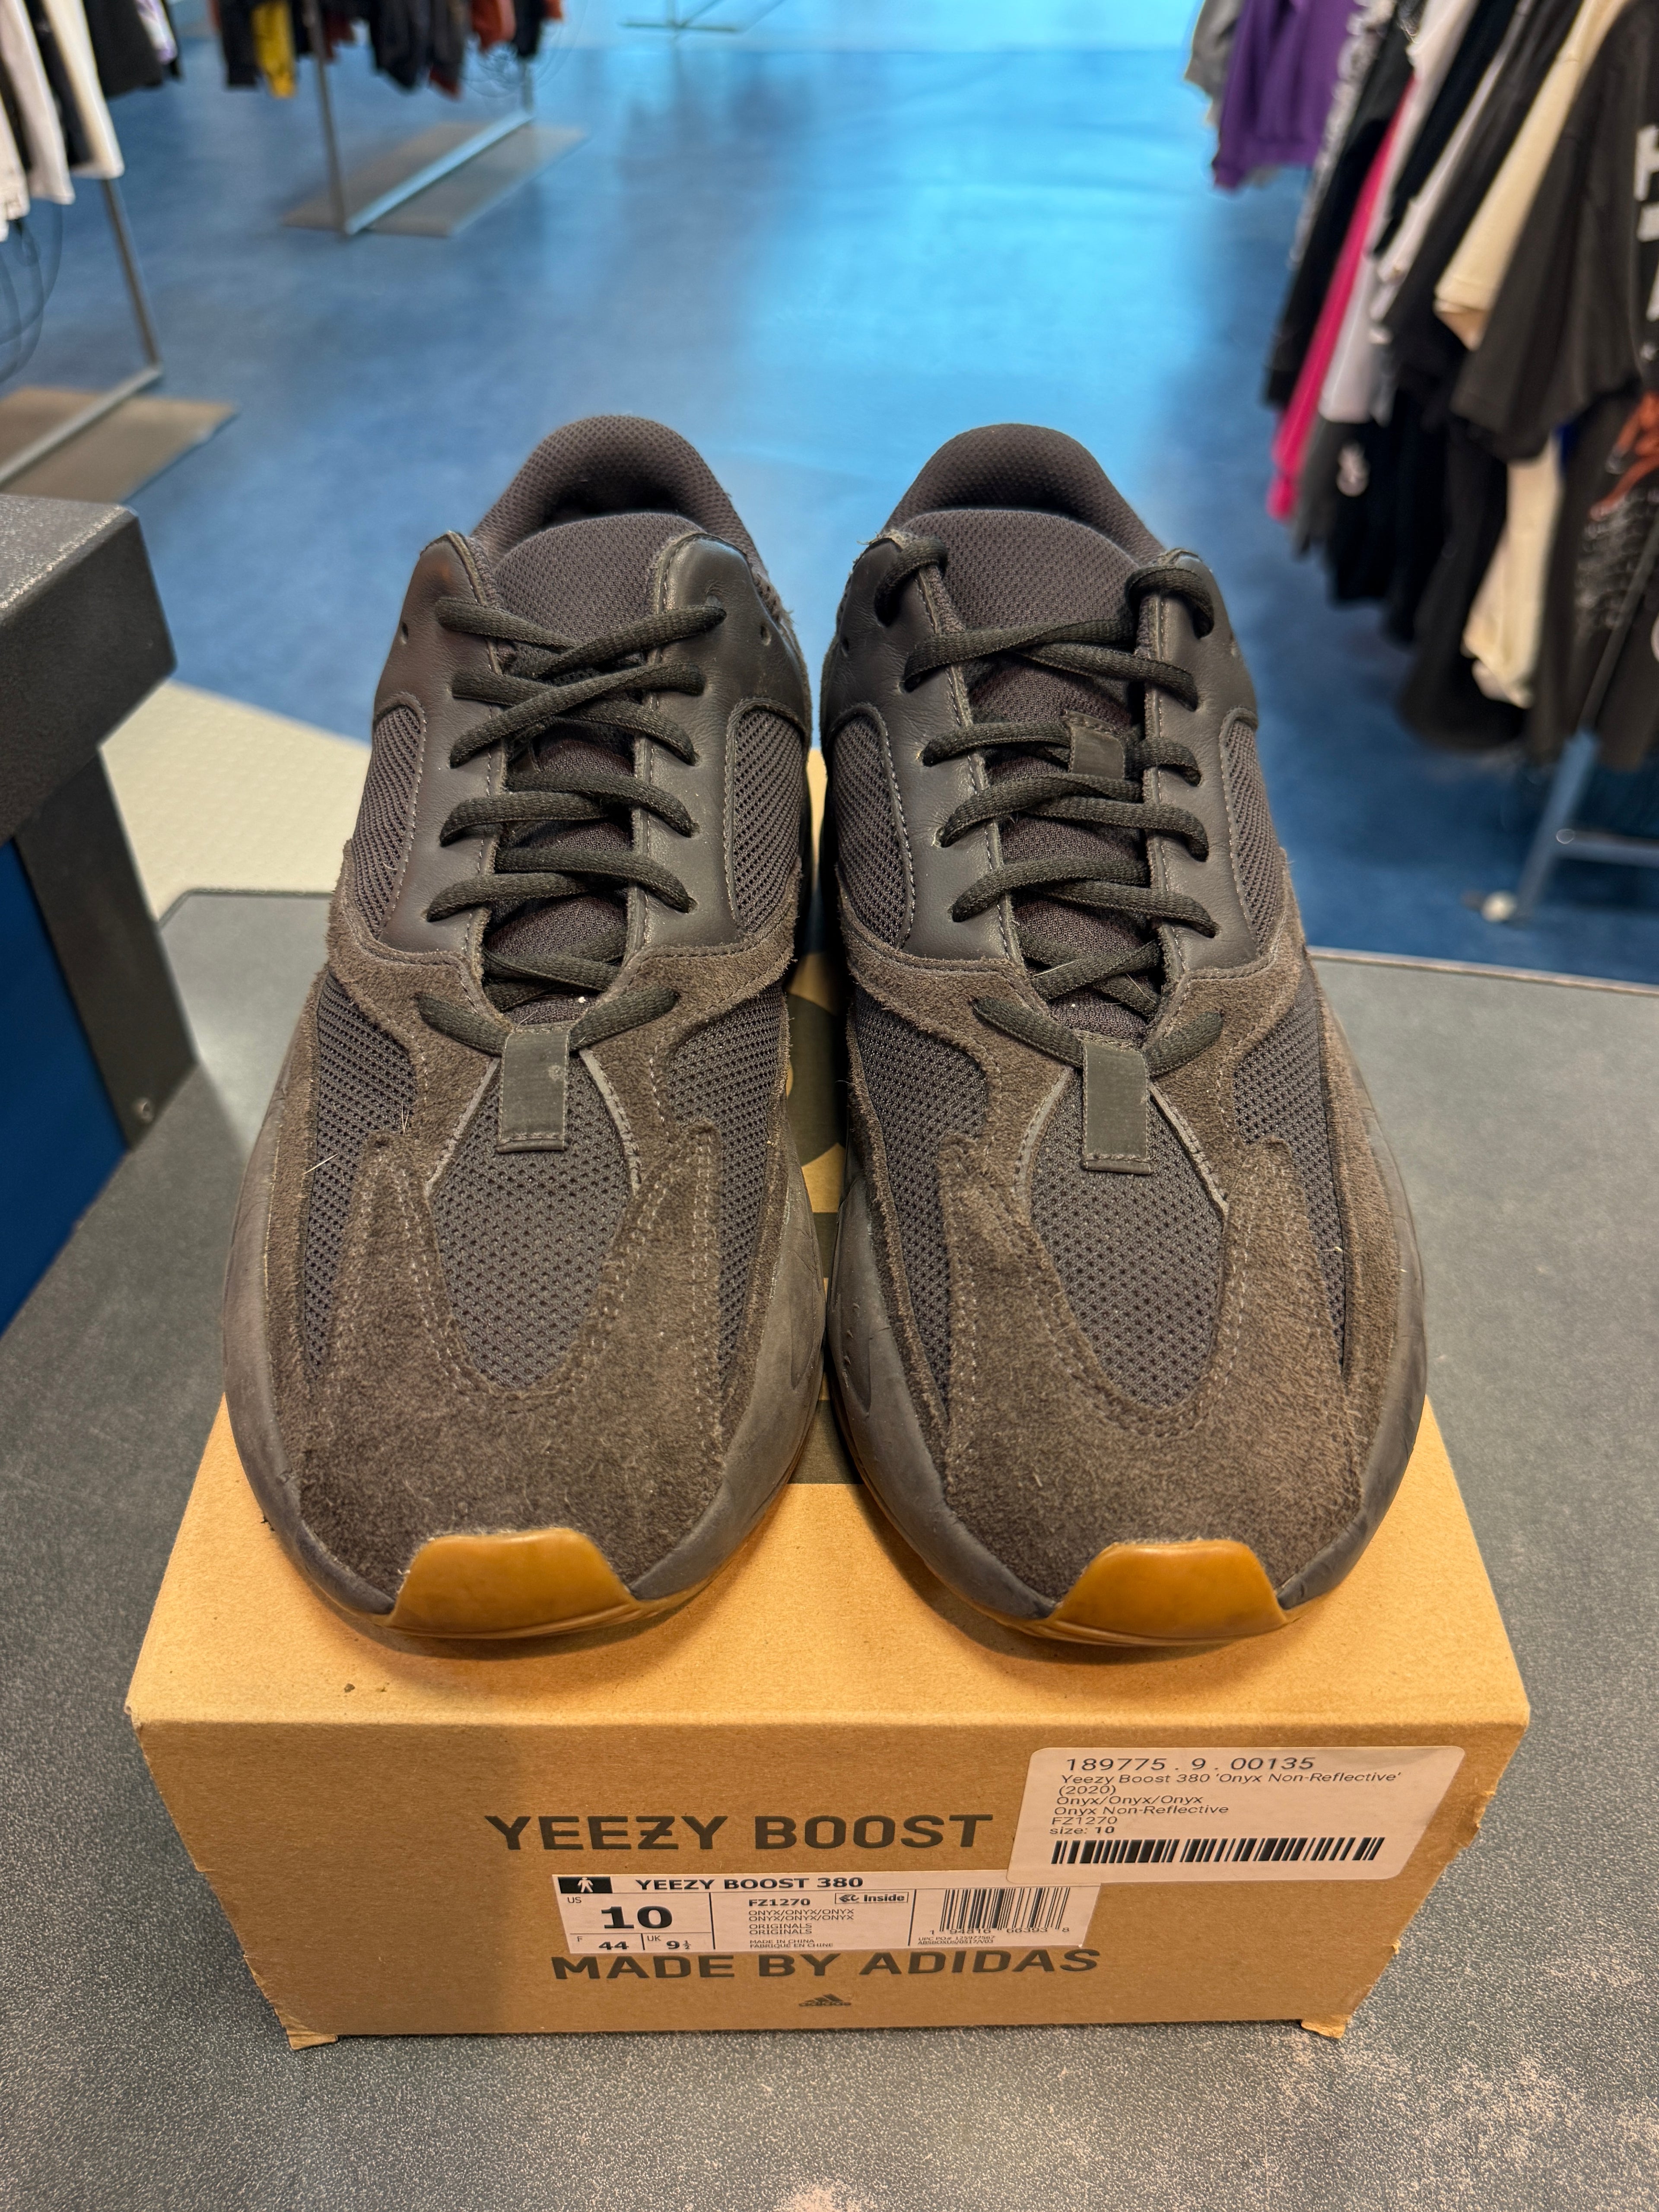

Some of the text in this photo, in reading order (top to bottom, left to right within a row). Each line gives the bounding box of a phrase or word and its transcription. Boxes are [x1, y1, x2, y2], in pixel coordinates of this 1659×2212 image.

[1067, 1758, 1167, 1771] 189775
[1192, 1758, 1206, 1770] 9
[1230, 1757, 1316, 1770] 00135
[1062, 1774, 1115, 1785] Yeezy
[1119, 1773, 1170, 1783] Boost
[1177, 1773, 1210, 1783] 380
[1058, 1785, 1116, 1796] (2020)
[1057, 1795, 1203, 1806] Onyx/Onyx/Onyx
[1054, 1805, 1228, 1816] Onyx Non-Reflective
[1052, 1816, 1117, 1825] FZ1270
[485, 1814, 993, 1850] YEEZY BOOST
[1050, 1826, 1115, 1835] size: 10
[636, 1877, 863, 1890] YEEZY BOOST 380
[749, 1898, 810, 1907] FZ1270
[864, 1893, 905, 1903] Inside
[601, 1905, 673, 1929] 10
[598, 1941, 629, 1950] 44
[551, 1948, 1101, 1980] MADE BY ADIDAS
